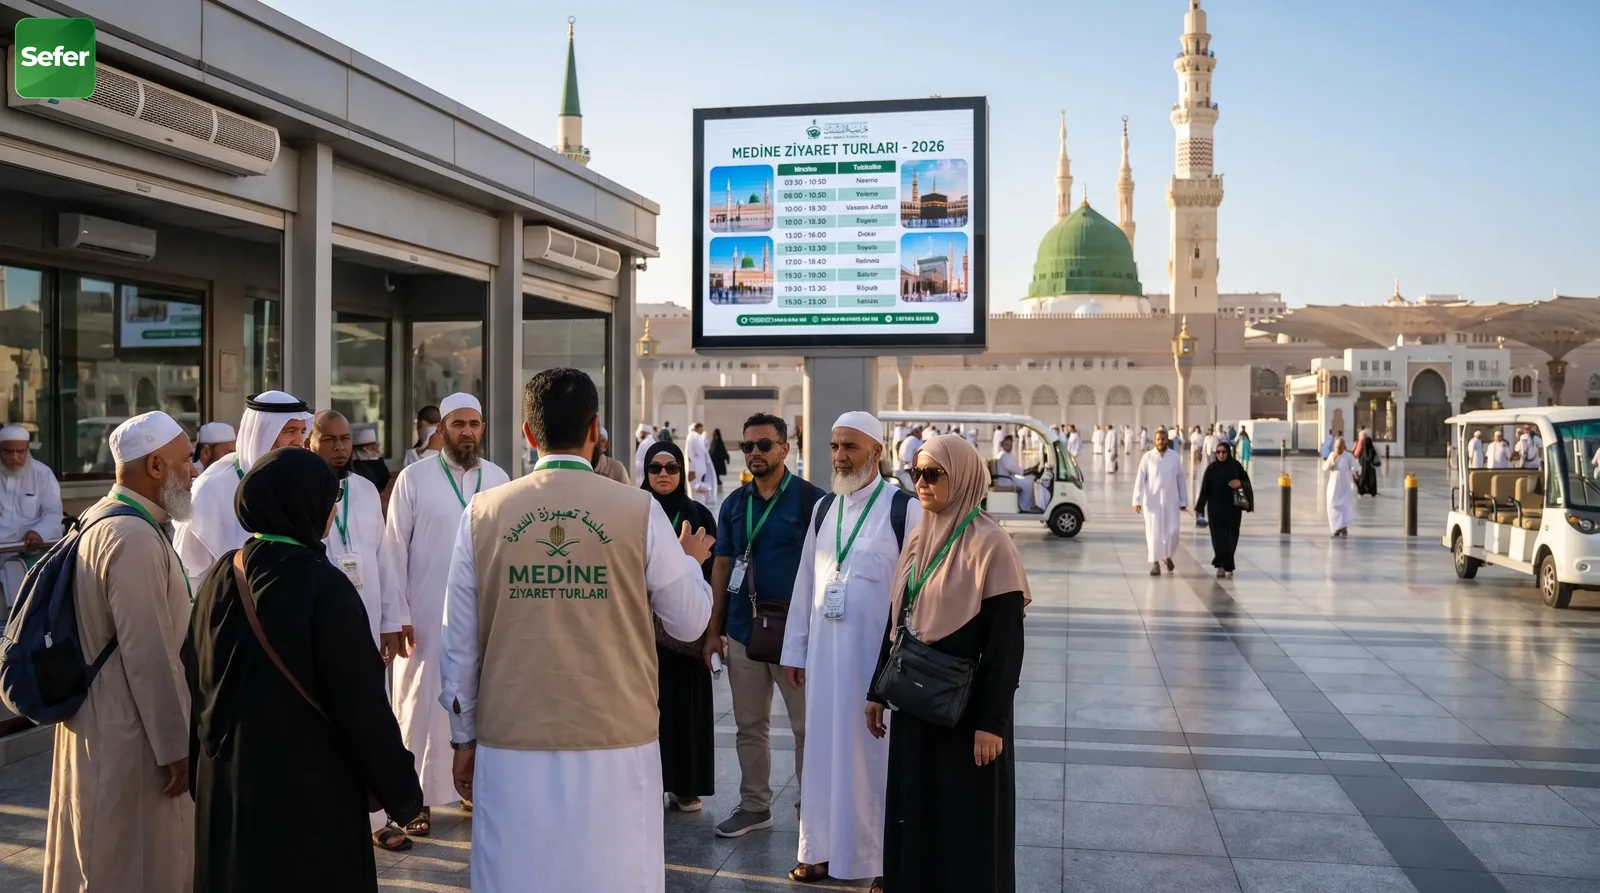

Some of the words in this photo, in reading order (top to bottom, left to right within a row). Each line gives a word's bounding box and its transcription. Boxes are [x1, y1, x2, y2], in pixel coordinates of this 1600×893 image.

[732, 144, 781, 159] MEDİNE
[785, 142, 838, 157] ZİYARET
[842, 142, 899, 155] TURLARI
[911, 140, 945, 153] 2026
[509, 560, 607, 584] MEDİNE
[509, 586, 556, 599] ZİYARET
[558, 588, 608, 599] TURLARI
